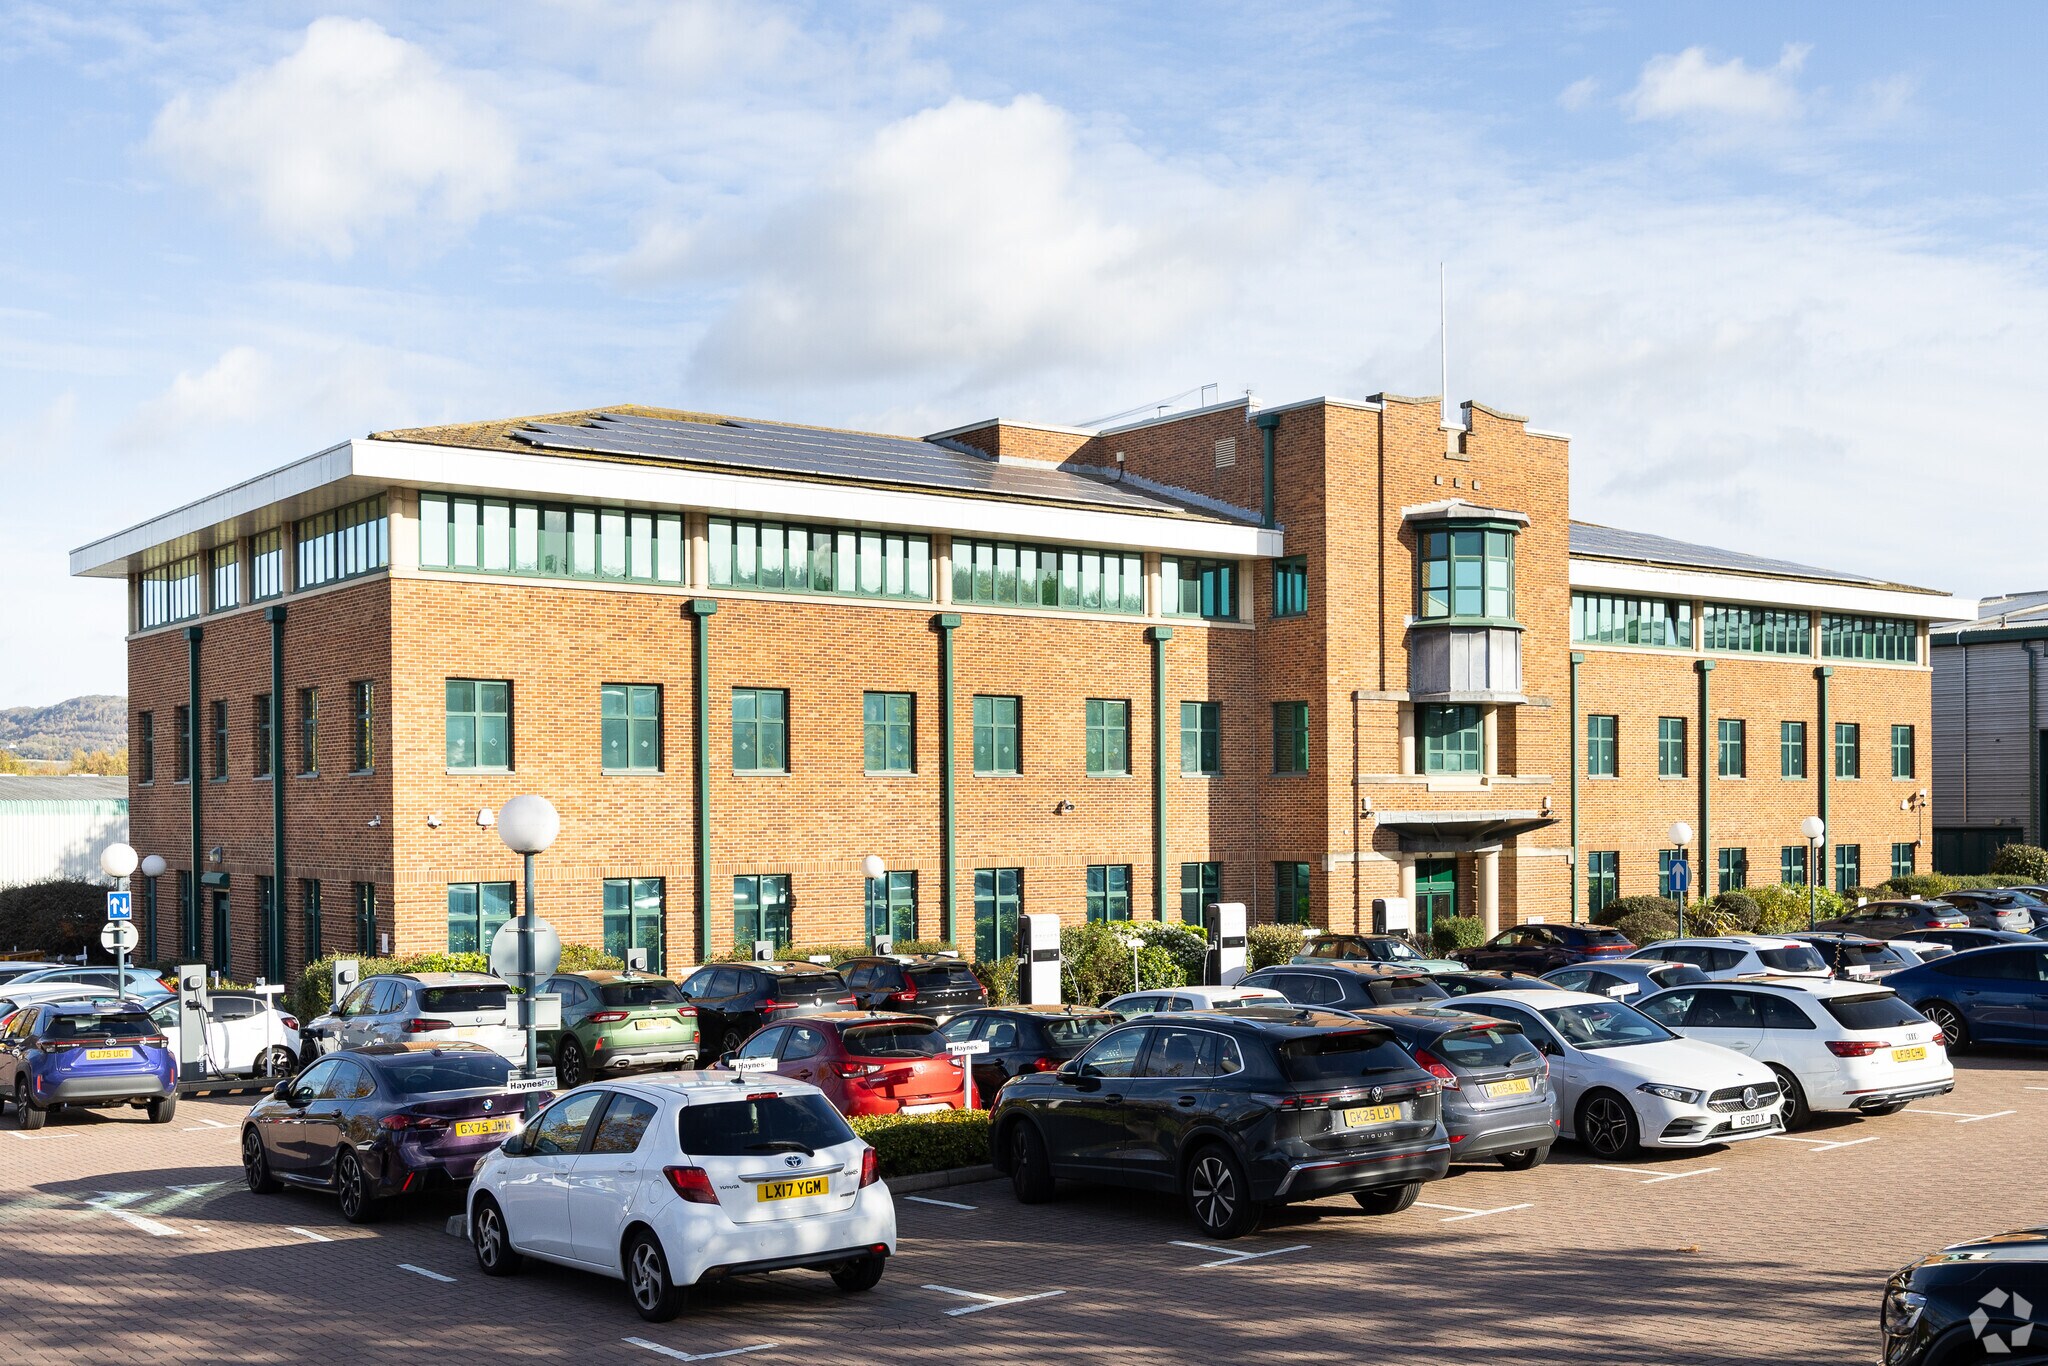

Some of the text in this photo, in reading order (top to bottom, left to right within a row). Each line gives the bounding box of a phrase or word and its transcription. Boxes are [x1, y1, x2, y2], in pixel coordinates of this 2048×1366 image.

[90, 1049, 129, 1058] GJ75 UGT
[510, 1079, 555, 1090] HaynesPro
[1514, 1081, 1530, 1091] XUL
[1349, 1106, 1396, 1123] GK25 LBY
[460, 1122, 488, 1134] GX75
[1360, 1131, 1394, 1140] TIGUAN
[766, 1183, 794, 1199] LX17
[797, 1180, 821, 1196] YGM
